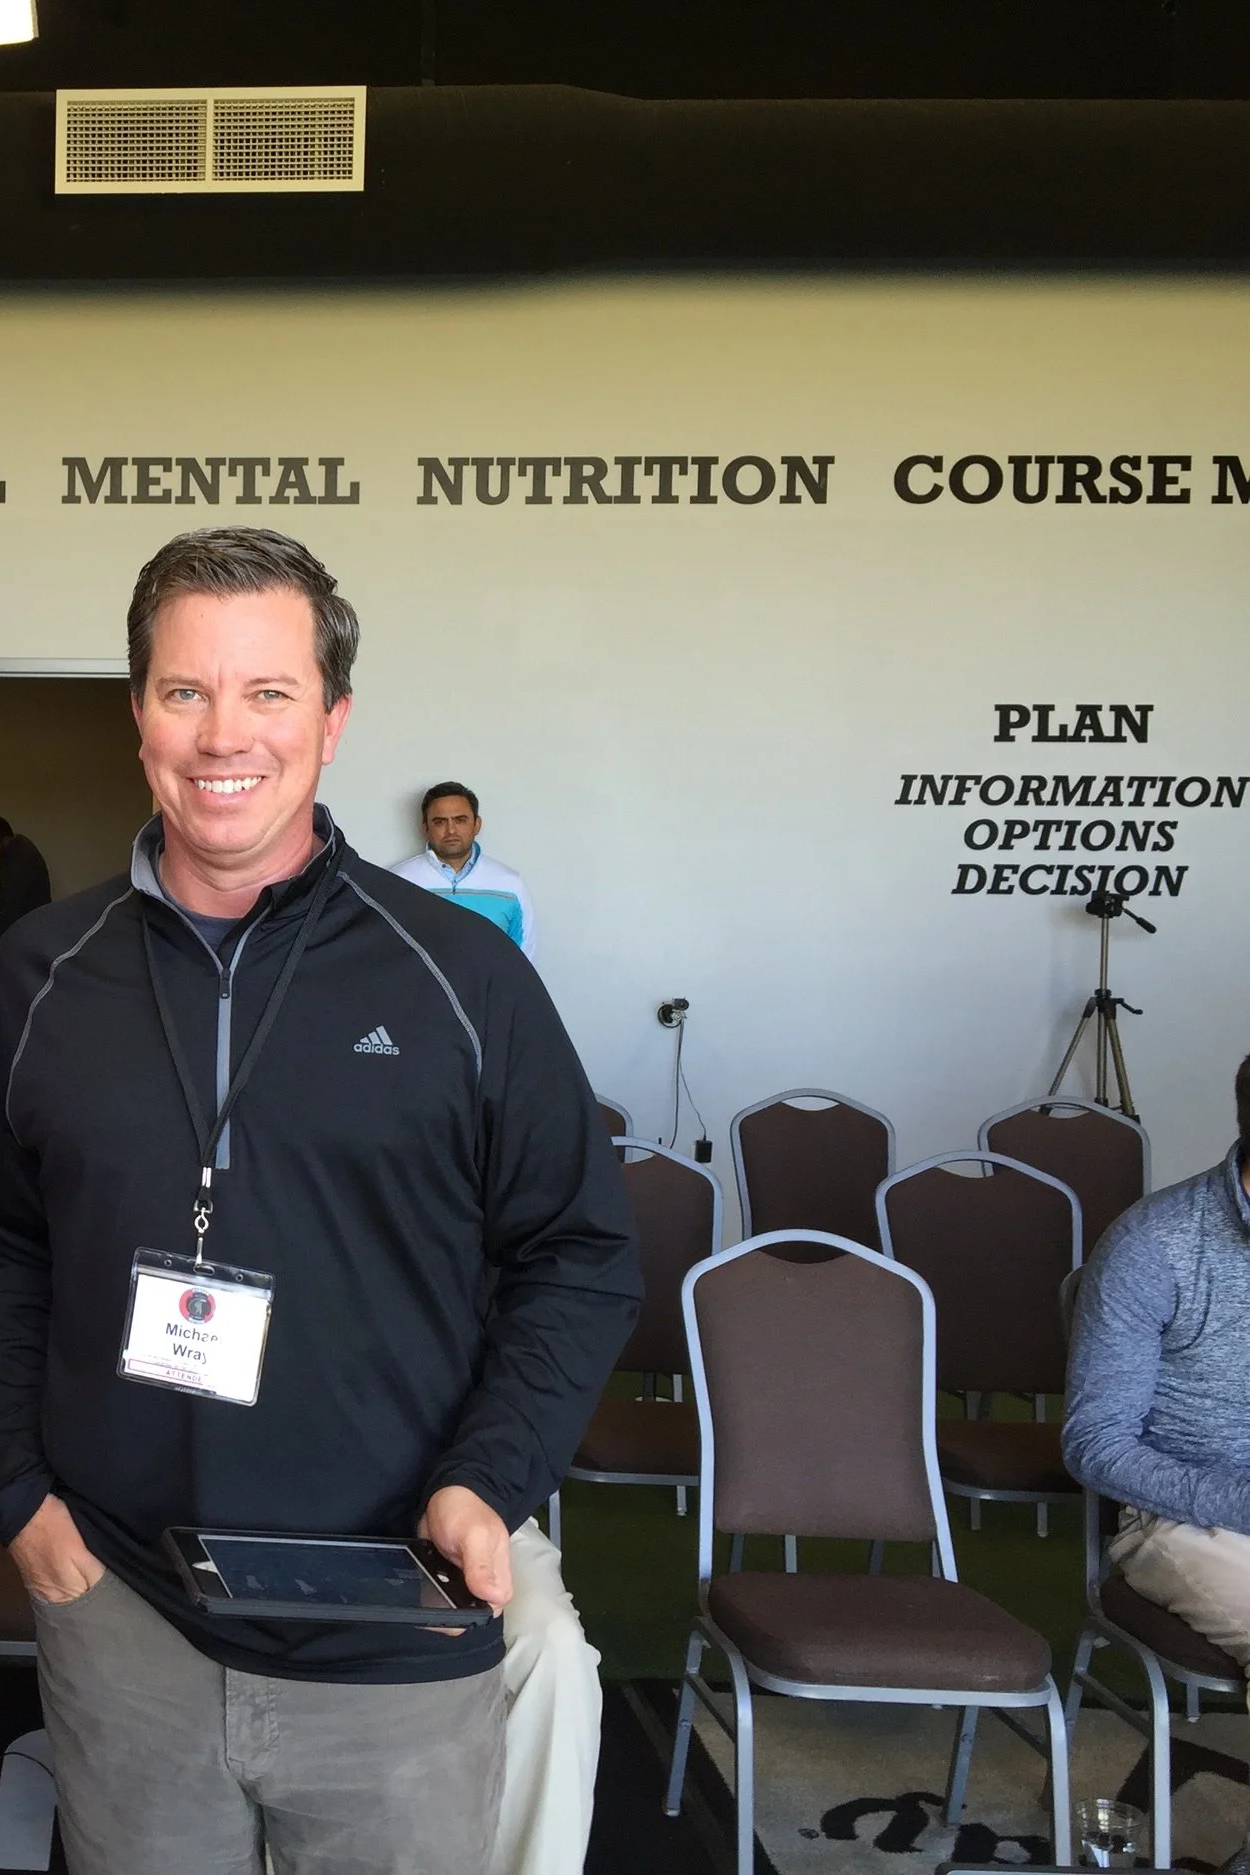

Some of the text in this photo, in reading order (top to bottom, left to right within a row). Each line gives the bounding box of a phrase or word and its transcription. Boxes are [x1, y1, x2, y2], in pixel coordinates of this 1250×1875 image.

[61, 456, 361, 505] MENTAL
[416, 456, 835, 506] NUTRITION
[893, 454, 1192, 505] COURSE
[994, 704, 1154, 743] PLAN
[894, 774, 1250, 808] INFORMATION
[963, 818, 1178, 852] OPTIONS
[951, 864, 1189, 897] DECISION
[354, 1042, 400, 1056] adidas
